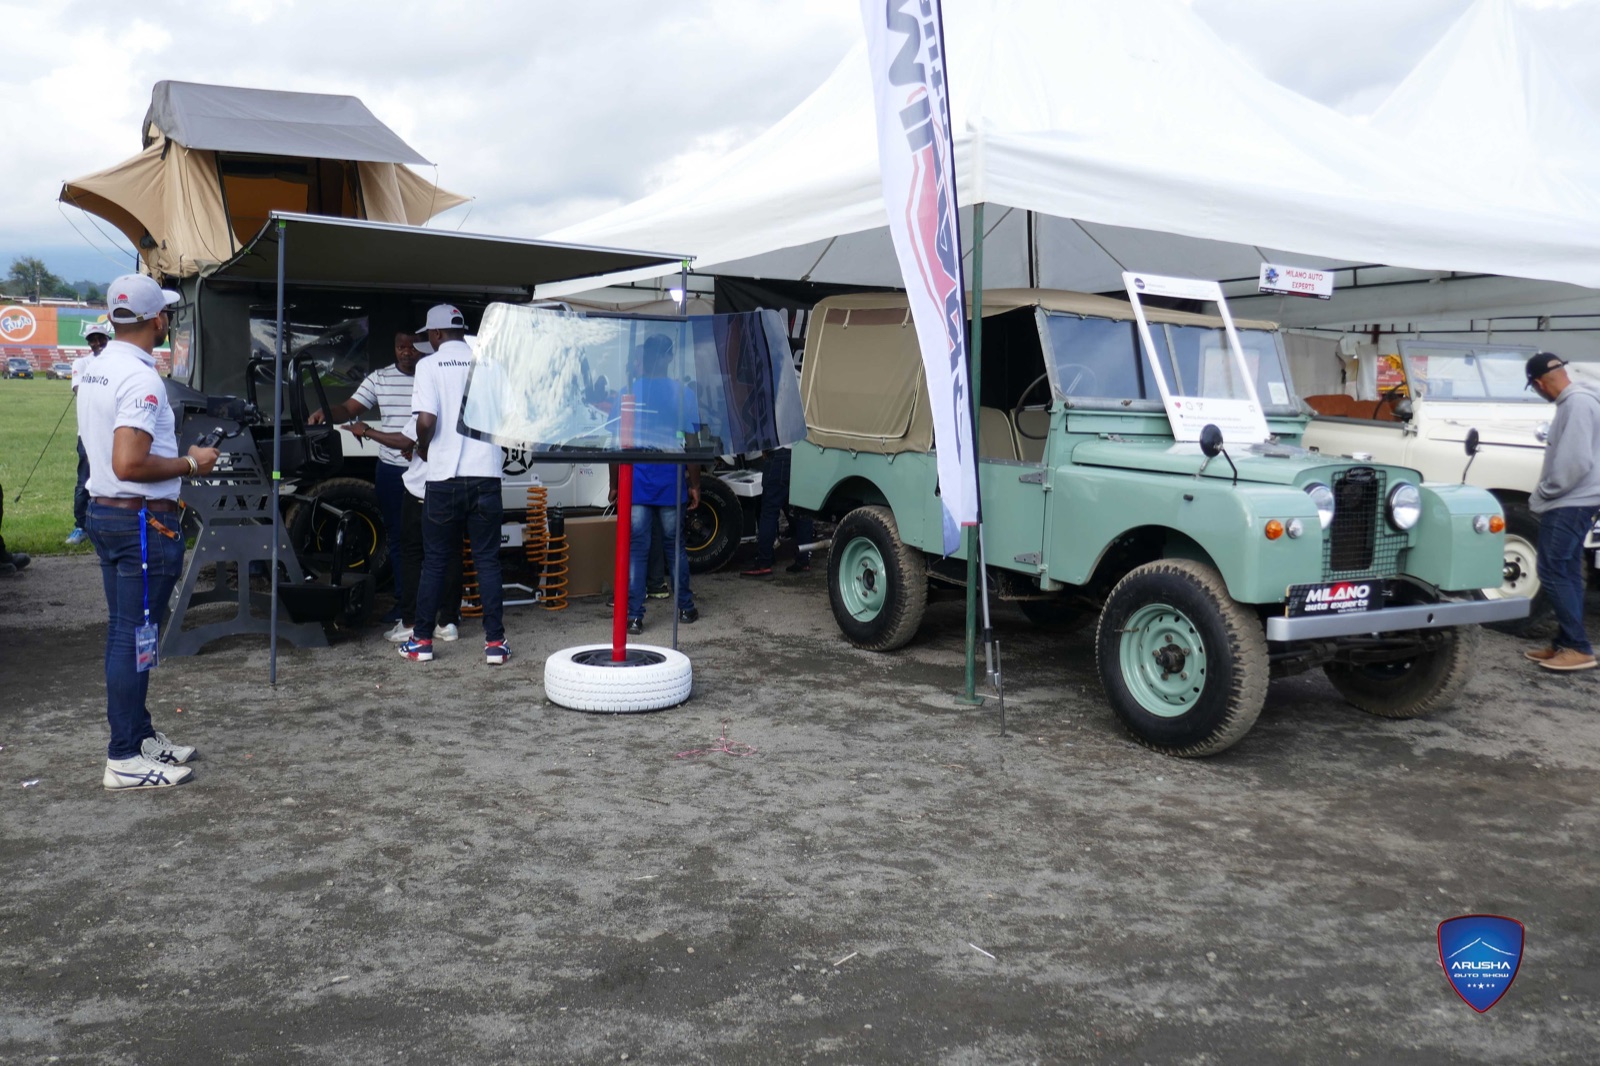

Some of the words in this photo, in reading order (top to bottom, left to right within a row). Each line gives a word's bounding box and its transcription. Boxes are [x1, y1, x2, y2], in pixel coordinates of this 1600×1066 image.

[1308, 272, 1324, 282] AUTO
[1292, 281, 1315, 291] EXPERTS
[2, 316, 31, 333] Fanta
[1305, 585, 1370, 603] MILANO
[1304, 603, 1329, 612] auto
[1330, 599, 1369, 610] experts
